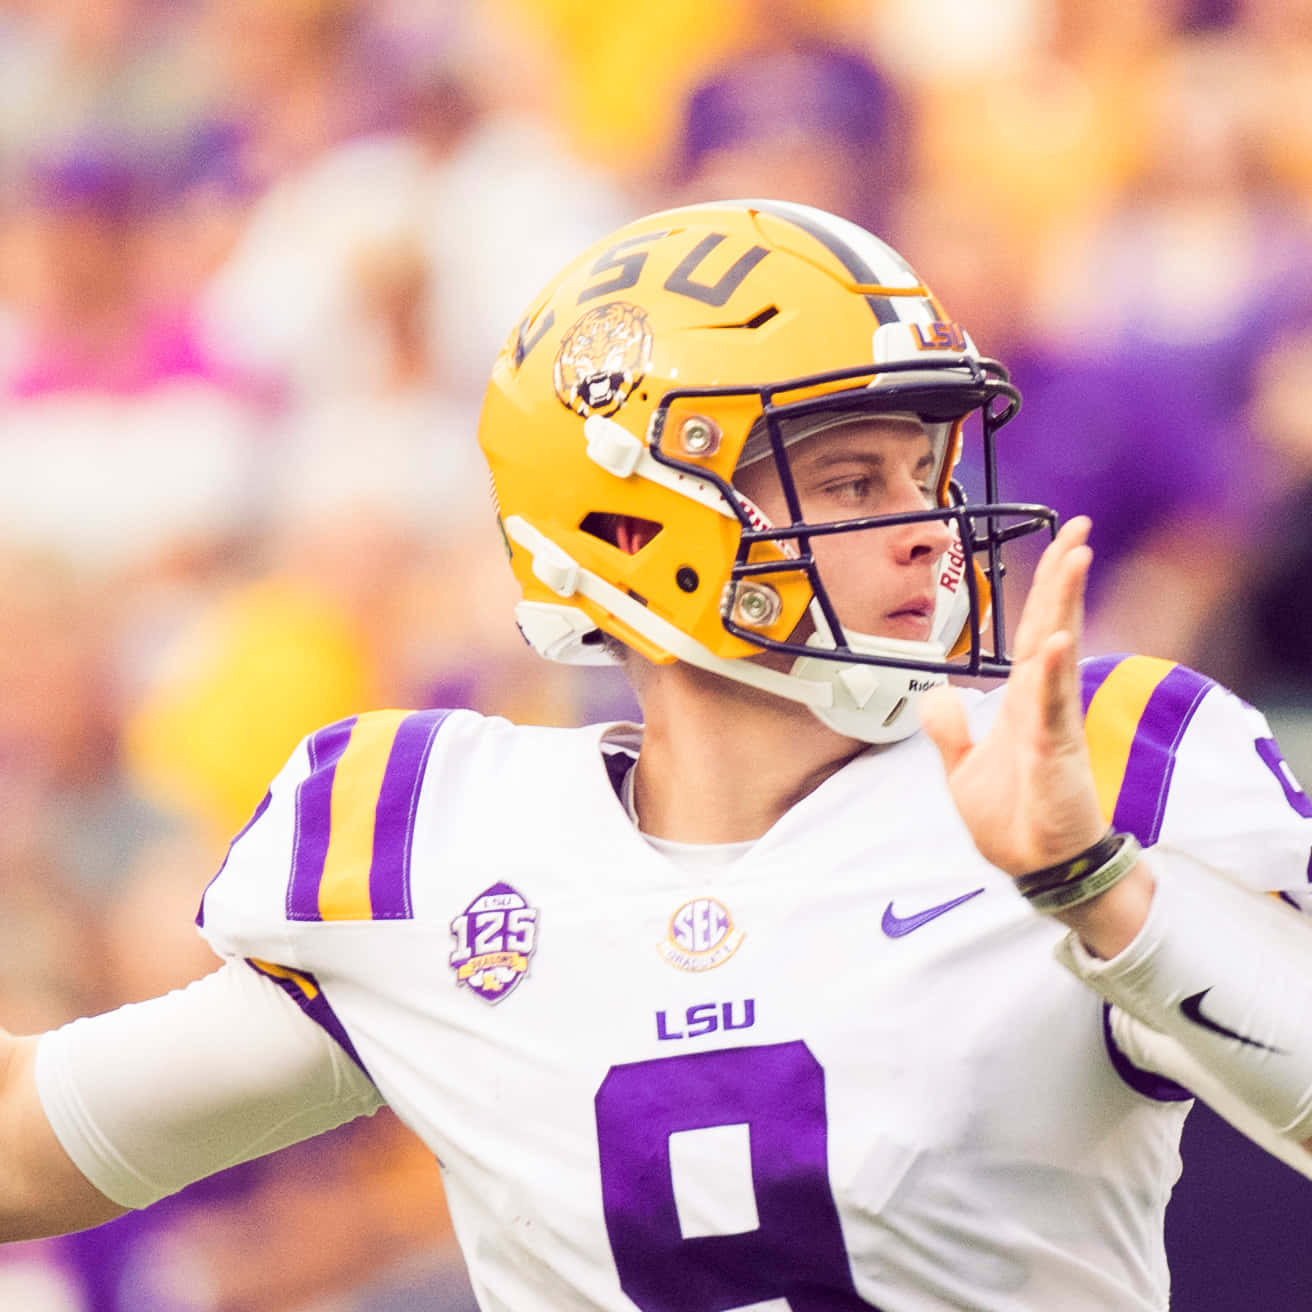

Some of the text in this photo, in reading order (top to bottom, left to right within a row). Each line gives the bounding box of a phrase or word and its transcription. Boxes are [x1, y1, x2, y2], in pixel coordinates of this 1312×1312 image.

[514, 231, 772, 371] LSU
[909, 323, 967, 352] LSU
[449, 907, 537, 963] 125
[673, 900, 729, 952] SEC
[656, 999, 755, 1041] LSU
